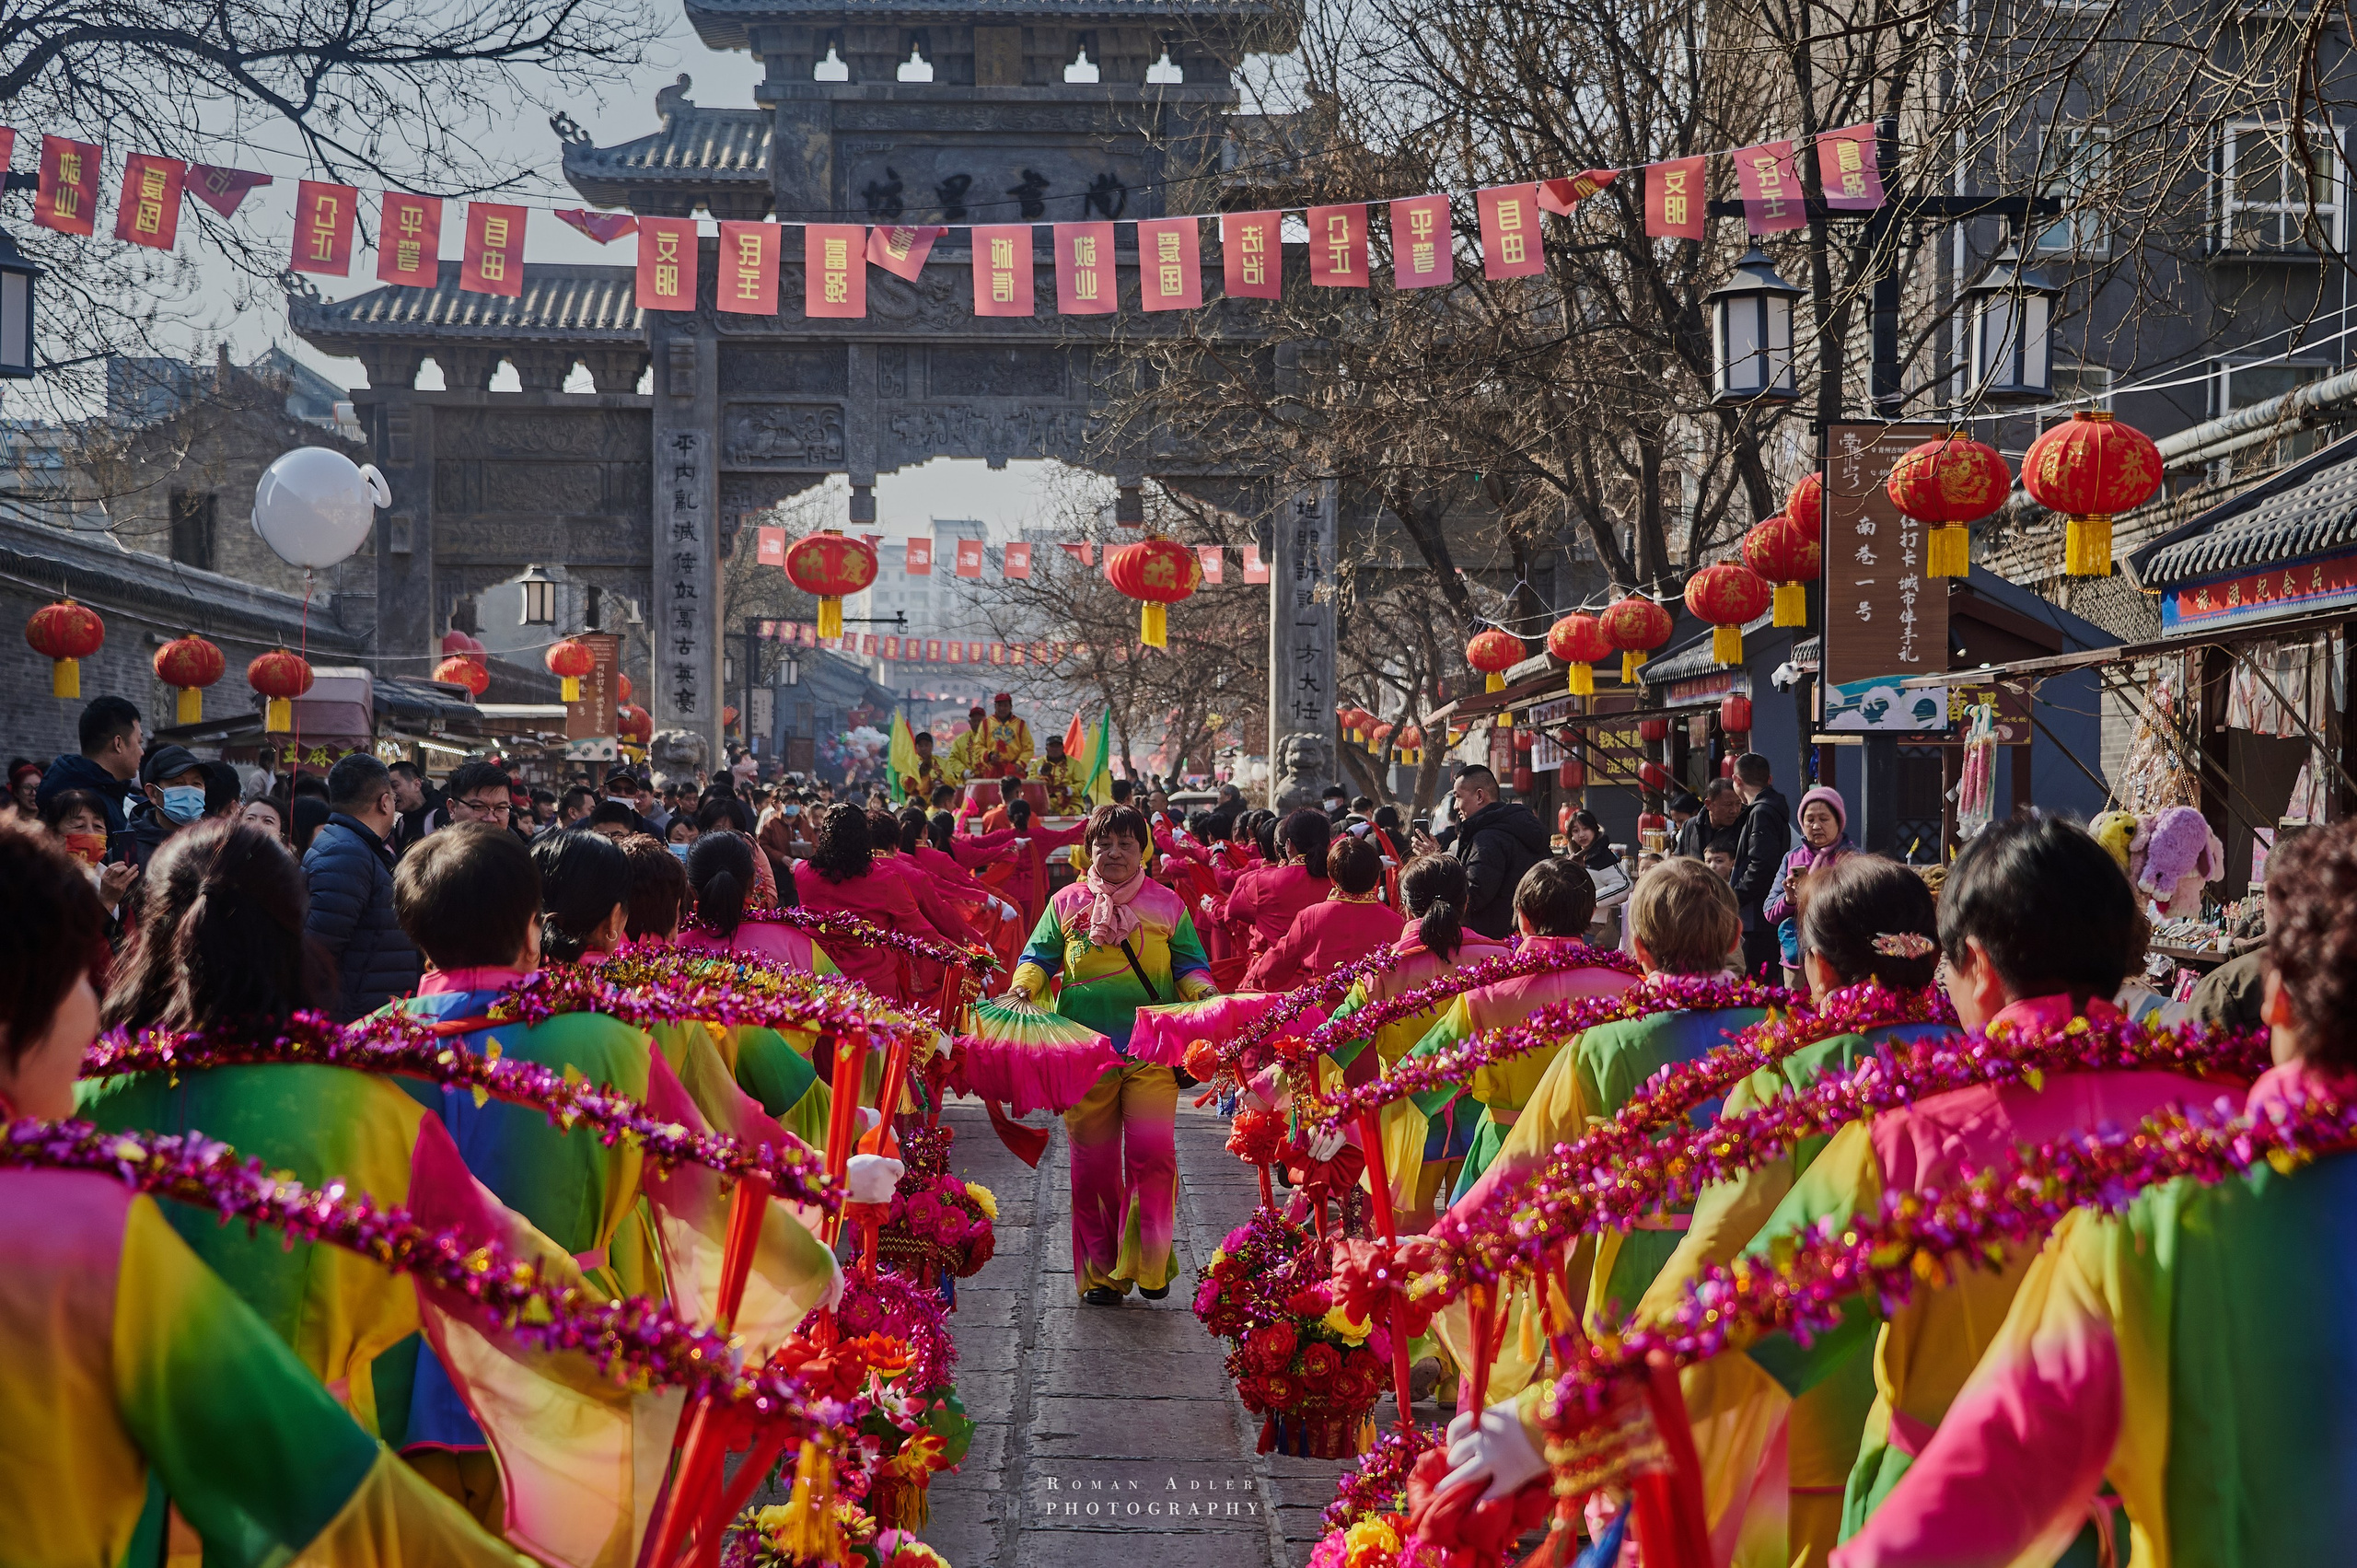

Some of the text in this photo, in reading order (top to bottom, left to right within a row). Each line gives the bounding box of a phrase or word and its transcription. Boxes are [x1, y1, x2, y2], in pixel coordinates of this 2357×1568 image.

[1854, 516, 1877, 621] 南巷一号
[283, 742, 355, 768] 王麻
